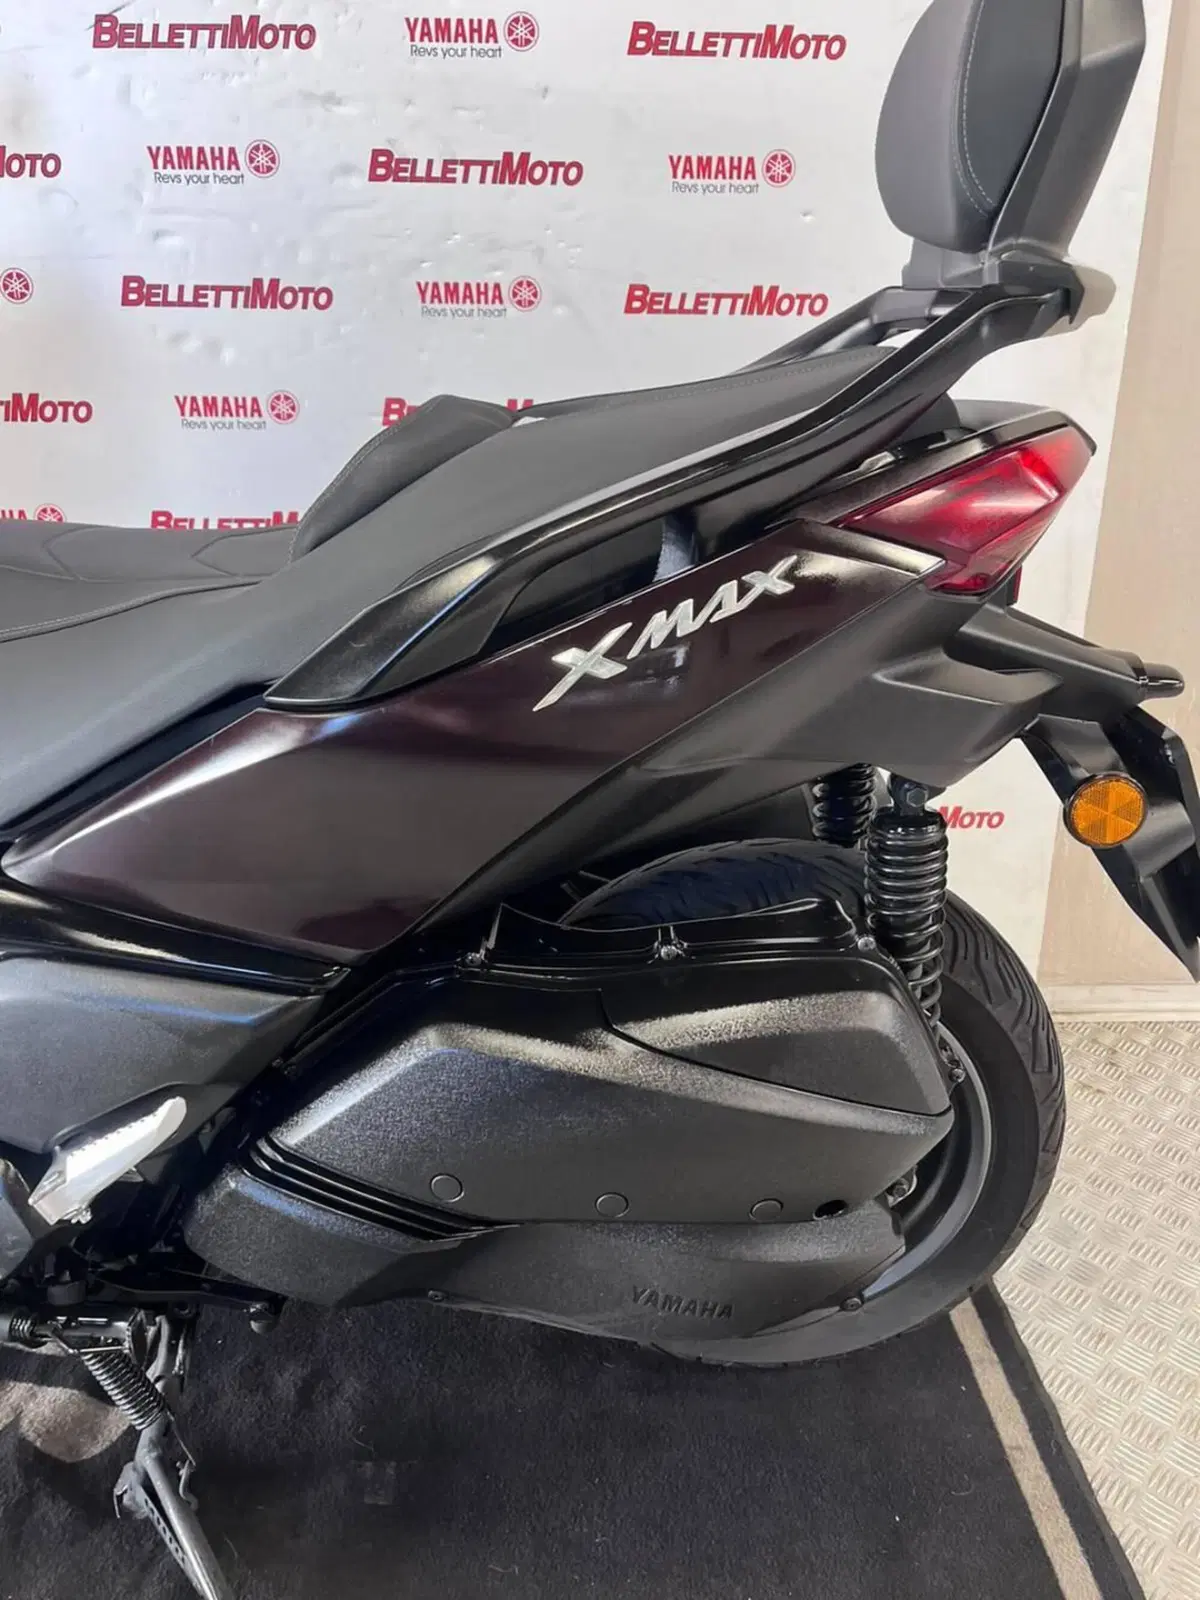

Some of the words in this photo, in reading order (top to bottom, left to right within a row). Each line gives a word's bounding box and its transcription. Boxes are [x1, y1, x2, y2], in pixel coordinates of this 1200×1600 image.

[404, 16, 499, 44] YAMAHA
[410, 44, 438, 57] Revs
[441, 47, 467, 59] your
[470, 45, 502, 58] heart
[0, 145, 61, 178] OTO
[147, 145, 241, 171] YAMAHA
[668, 154, 757, 181] YAMAHA
[154, 171, 182, 184] Revs
[184, 174, 210, 186] your
[213, 172, 245, 185] heart
[672, 181, 699, 193] Revs
[701, 183, 726, 195] your
[729, 182, 759, 194] heart
[416, 280, 504, 305] YAMAHA
[174, 395, 263, 418] YAMAHA
[632, 1284, 735, 1319] YAMAHA
